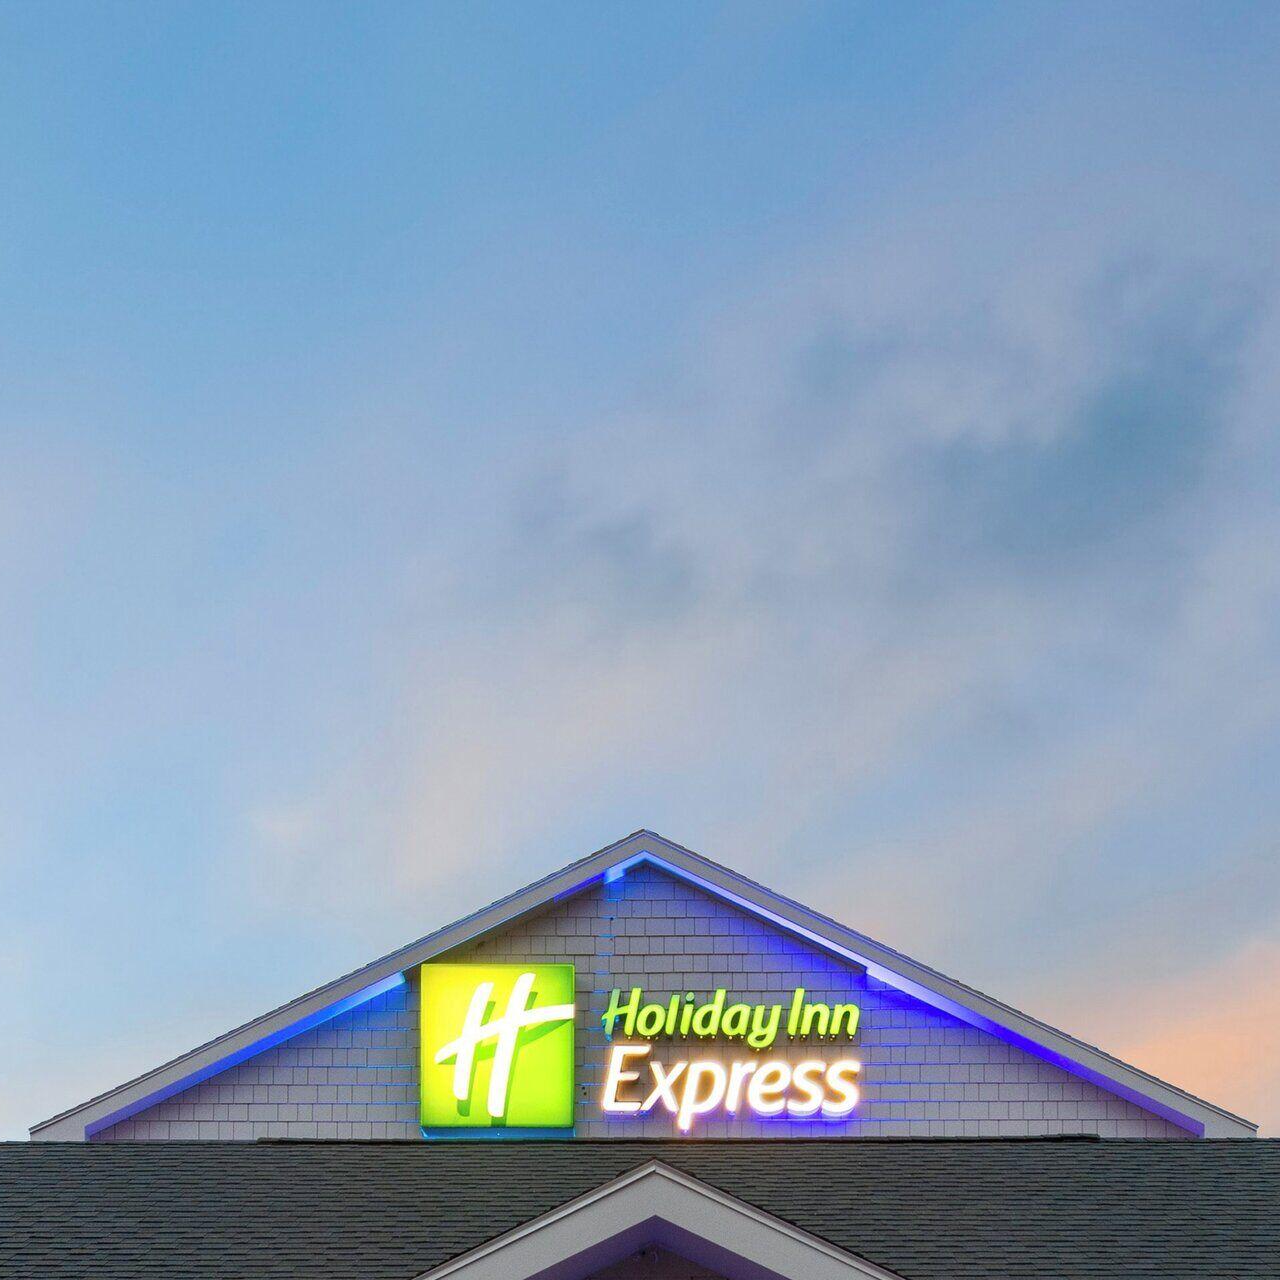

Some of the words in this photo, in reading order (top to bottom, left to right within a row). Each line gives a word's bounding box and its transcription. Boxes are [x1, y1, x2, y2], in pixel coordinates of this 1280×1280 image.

[601, 987, 782, 1048] Holiday
[787, 987, 860, 1036] Inn
[602, 1043, 862, 1131] Express
